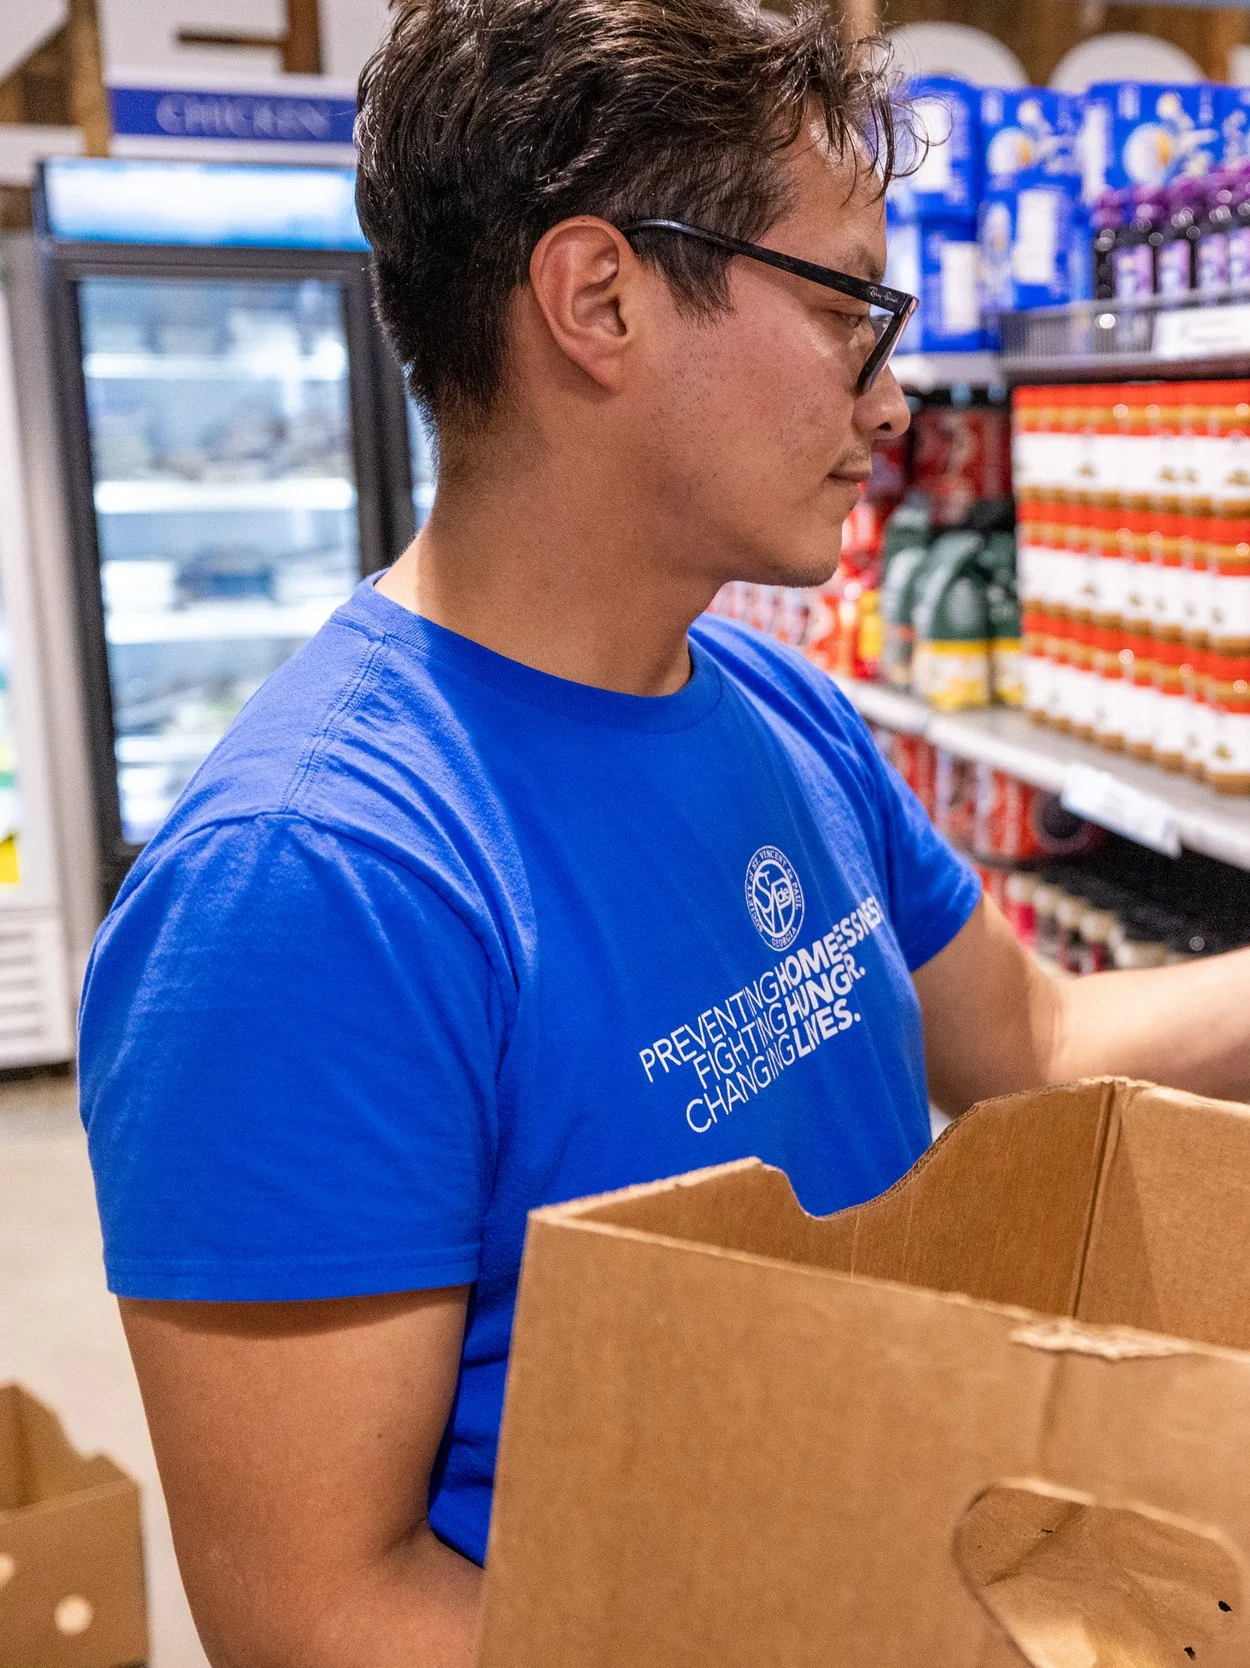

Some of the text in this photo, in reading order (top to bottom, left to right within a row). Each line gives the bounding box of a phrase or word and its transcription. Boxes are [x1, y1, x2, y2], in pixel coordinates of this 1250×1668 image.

[759, 849, 788, 867] VINCENT
[792, 881, 802, 911] PAUL
[771, 926, 798, 949] GEORGIA
[638, 968, 778, 1084] PREVENTING
[692, 1003, 790, 1091] FIGHTING
[685, 1033, 796, 1134] CHANGING
